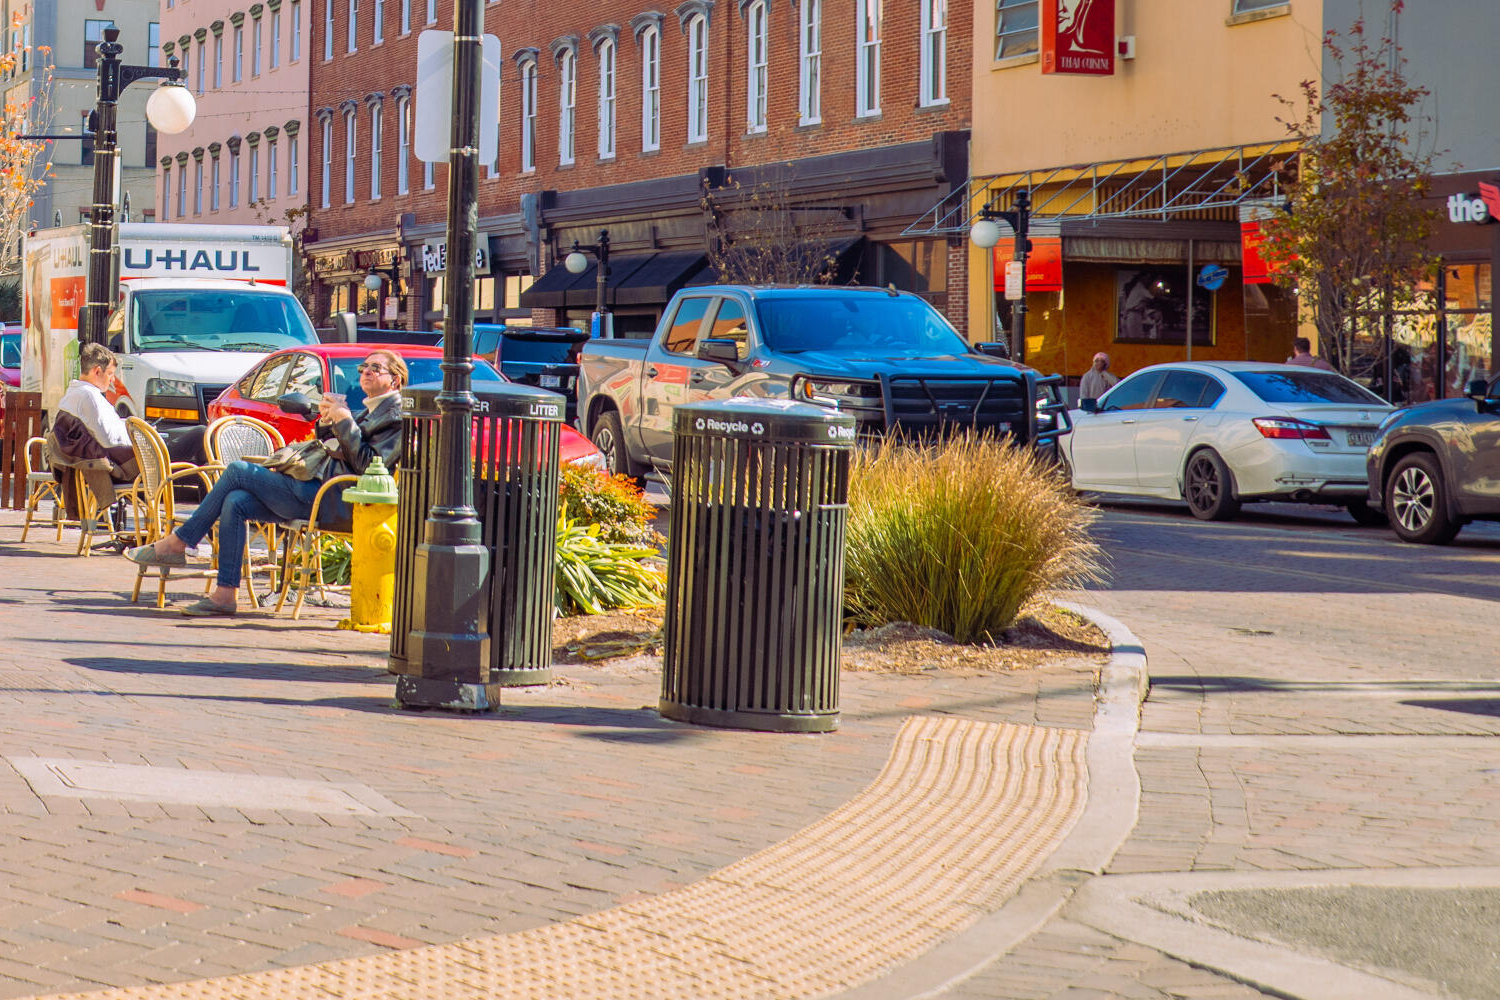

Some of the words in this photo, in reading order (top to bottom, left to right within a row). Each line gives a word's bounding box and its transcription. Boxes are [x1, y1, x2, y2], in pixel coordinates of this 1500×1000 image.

[1061, 57, 1080, 69] THAI
[1446, 192, 1487, 223] the
[124, 248, 260, 271] U-HAUL
[421, 242, 447, 272] FedE
[530, 404, 558, 417] LITTER
[707, 418, 749, 434] Recycle
